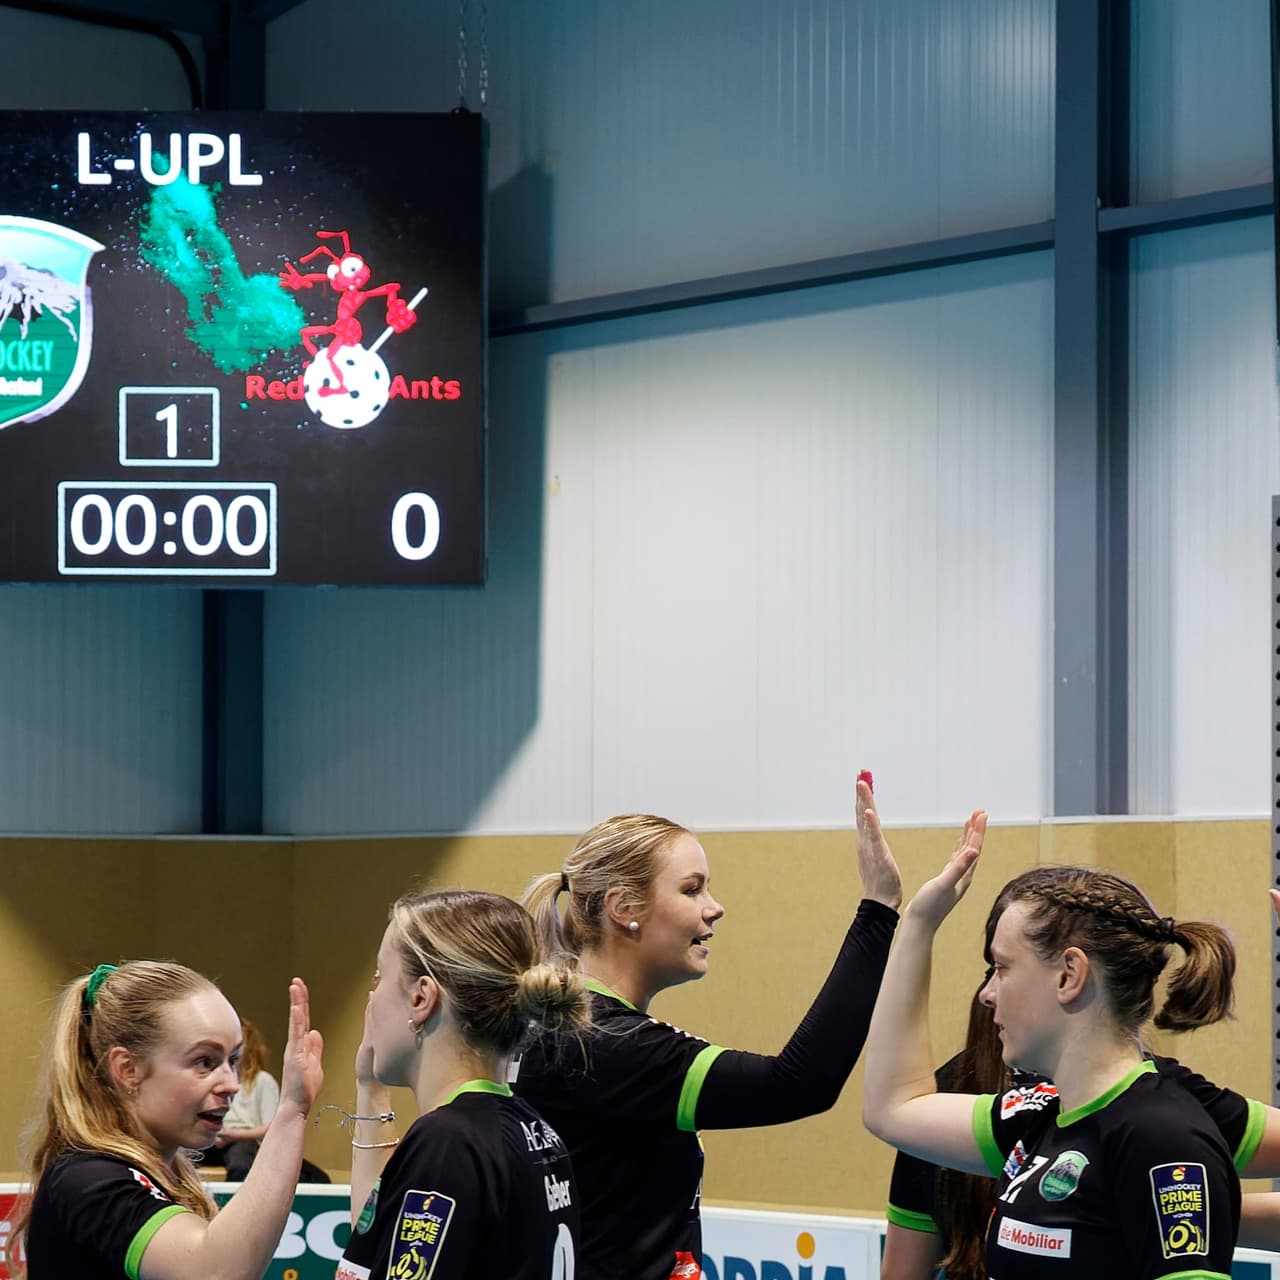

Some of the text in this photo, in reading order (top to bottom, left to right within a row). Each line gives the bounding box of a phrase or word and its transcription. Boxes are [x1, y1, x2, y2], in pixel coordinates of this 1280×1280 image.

[77, 131, 263, 186] L-UPL
[246, 374, 461, 400] Red Ants
[155, 404, 179, 458] 1
[70, 493, 269, 556] 00:00
[392, 492, 441, 560] 0
[1160, 1190, 1202, 1205] PRIME
[1162, 1202, 1202, 1215] LEAGUE
